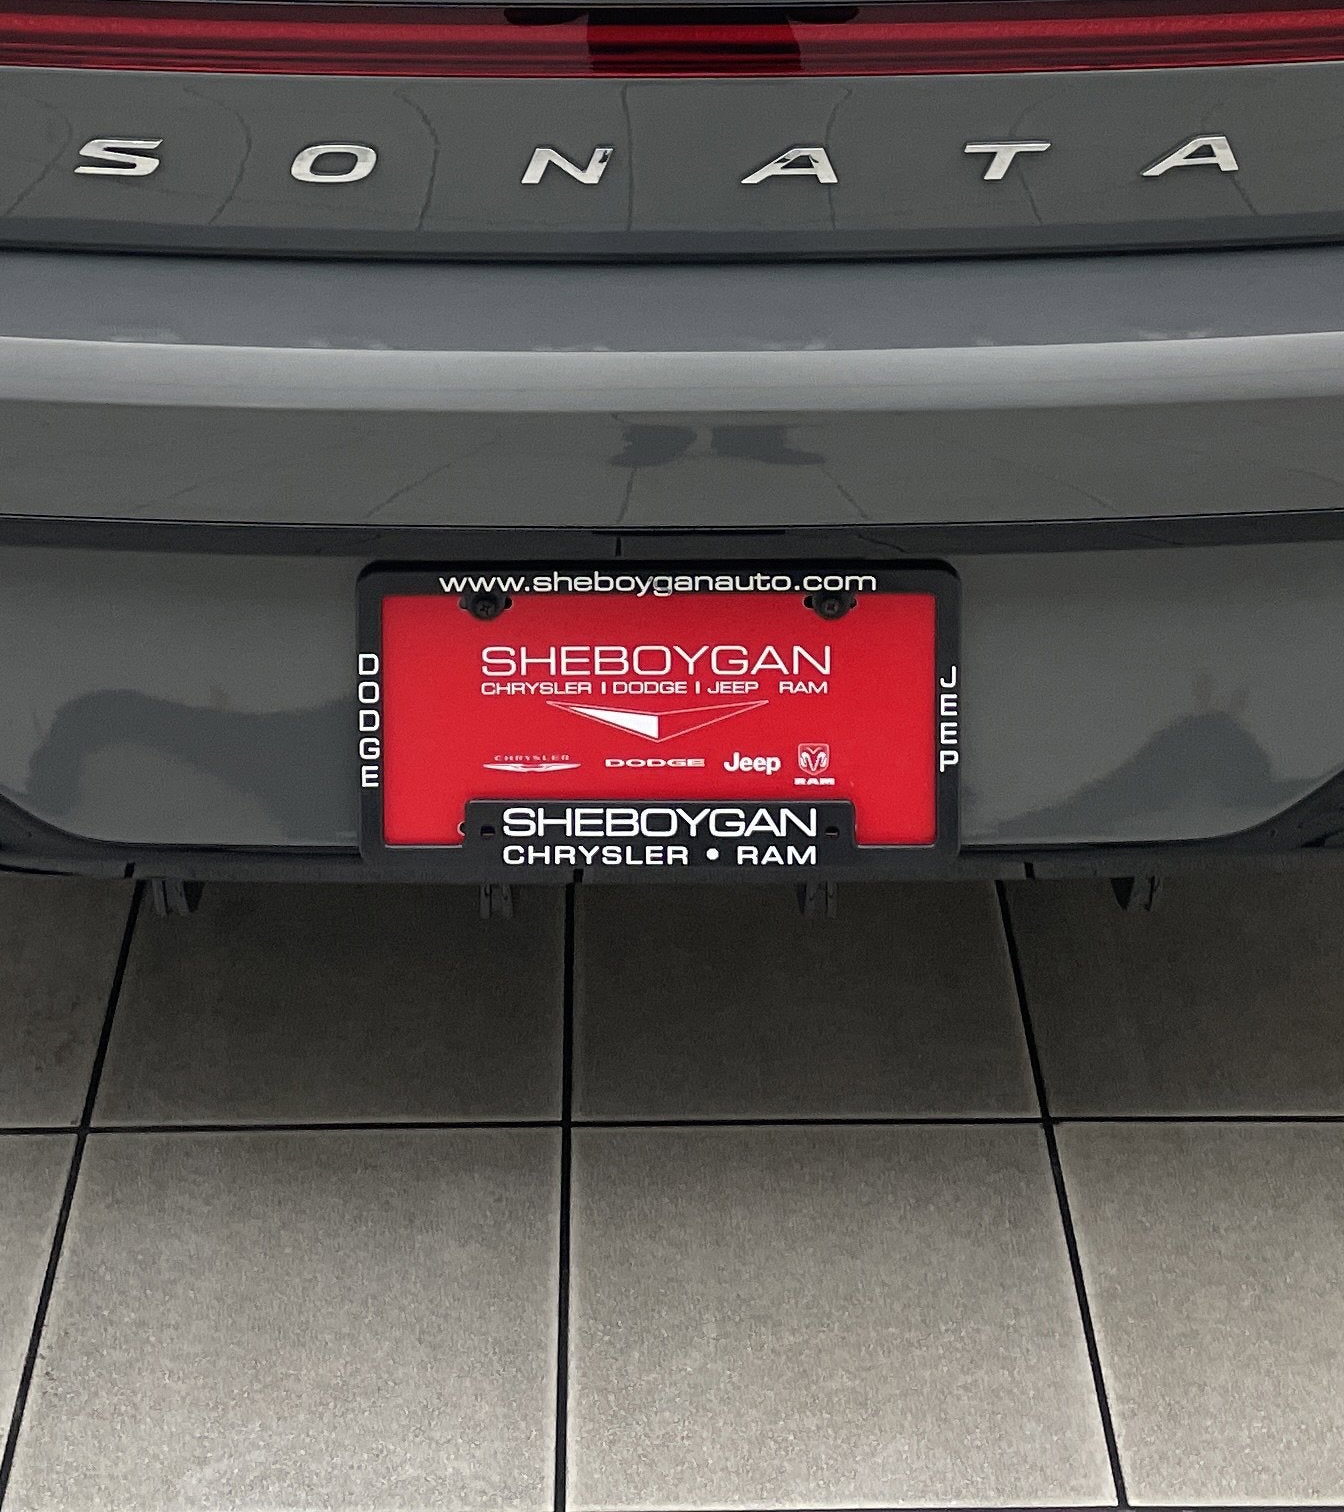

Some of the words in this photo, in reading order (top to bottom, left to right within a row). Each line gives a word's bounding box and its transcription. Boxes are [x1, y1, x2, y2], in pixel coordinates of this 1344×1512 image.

[73, 135, 1240, 185] SONATA
[438, 570, 877, 597] www.sheboyganauto.com
[481, 645, 831, 677] SHEBOYGAN
[481, 681, 592, 696] CHRYSLER
[613, 680, 688, 695] DODGE
[707, 680, 759, 695] JEEP
[779, 680, 829, 695] RAM
[358, 652, 381, 788] DODGE
[939, 665, 959, 773] JEEP
[604, 758, 706, 768] DODGE
[723, 751, 782, 776] Jeep
[794, 777, 836, 786] RAM
[502, 806, 818, 838] SHEBOYGAN
[502, 845, 689, 866] CHRYSLER
[736, 845, 818, 866] RAM
